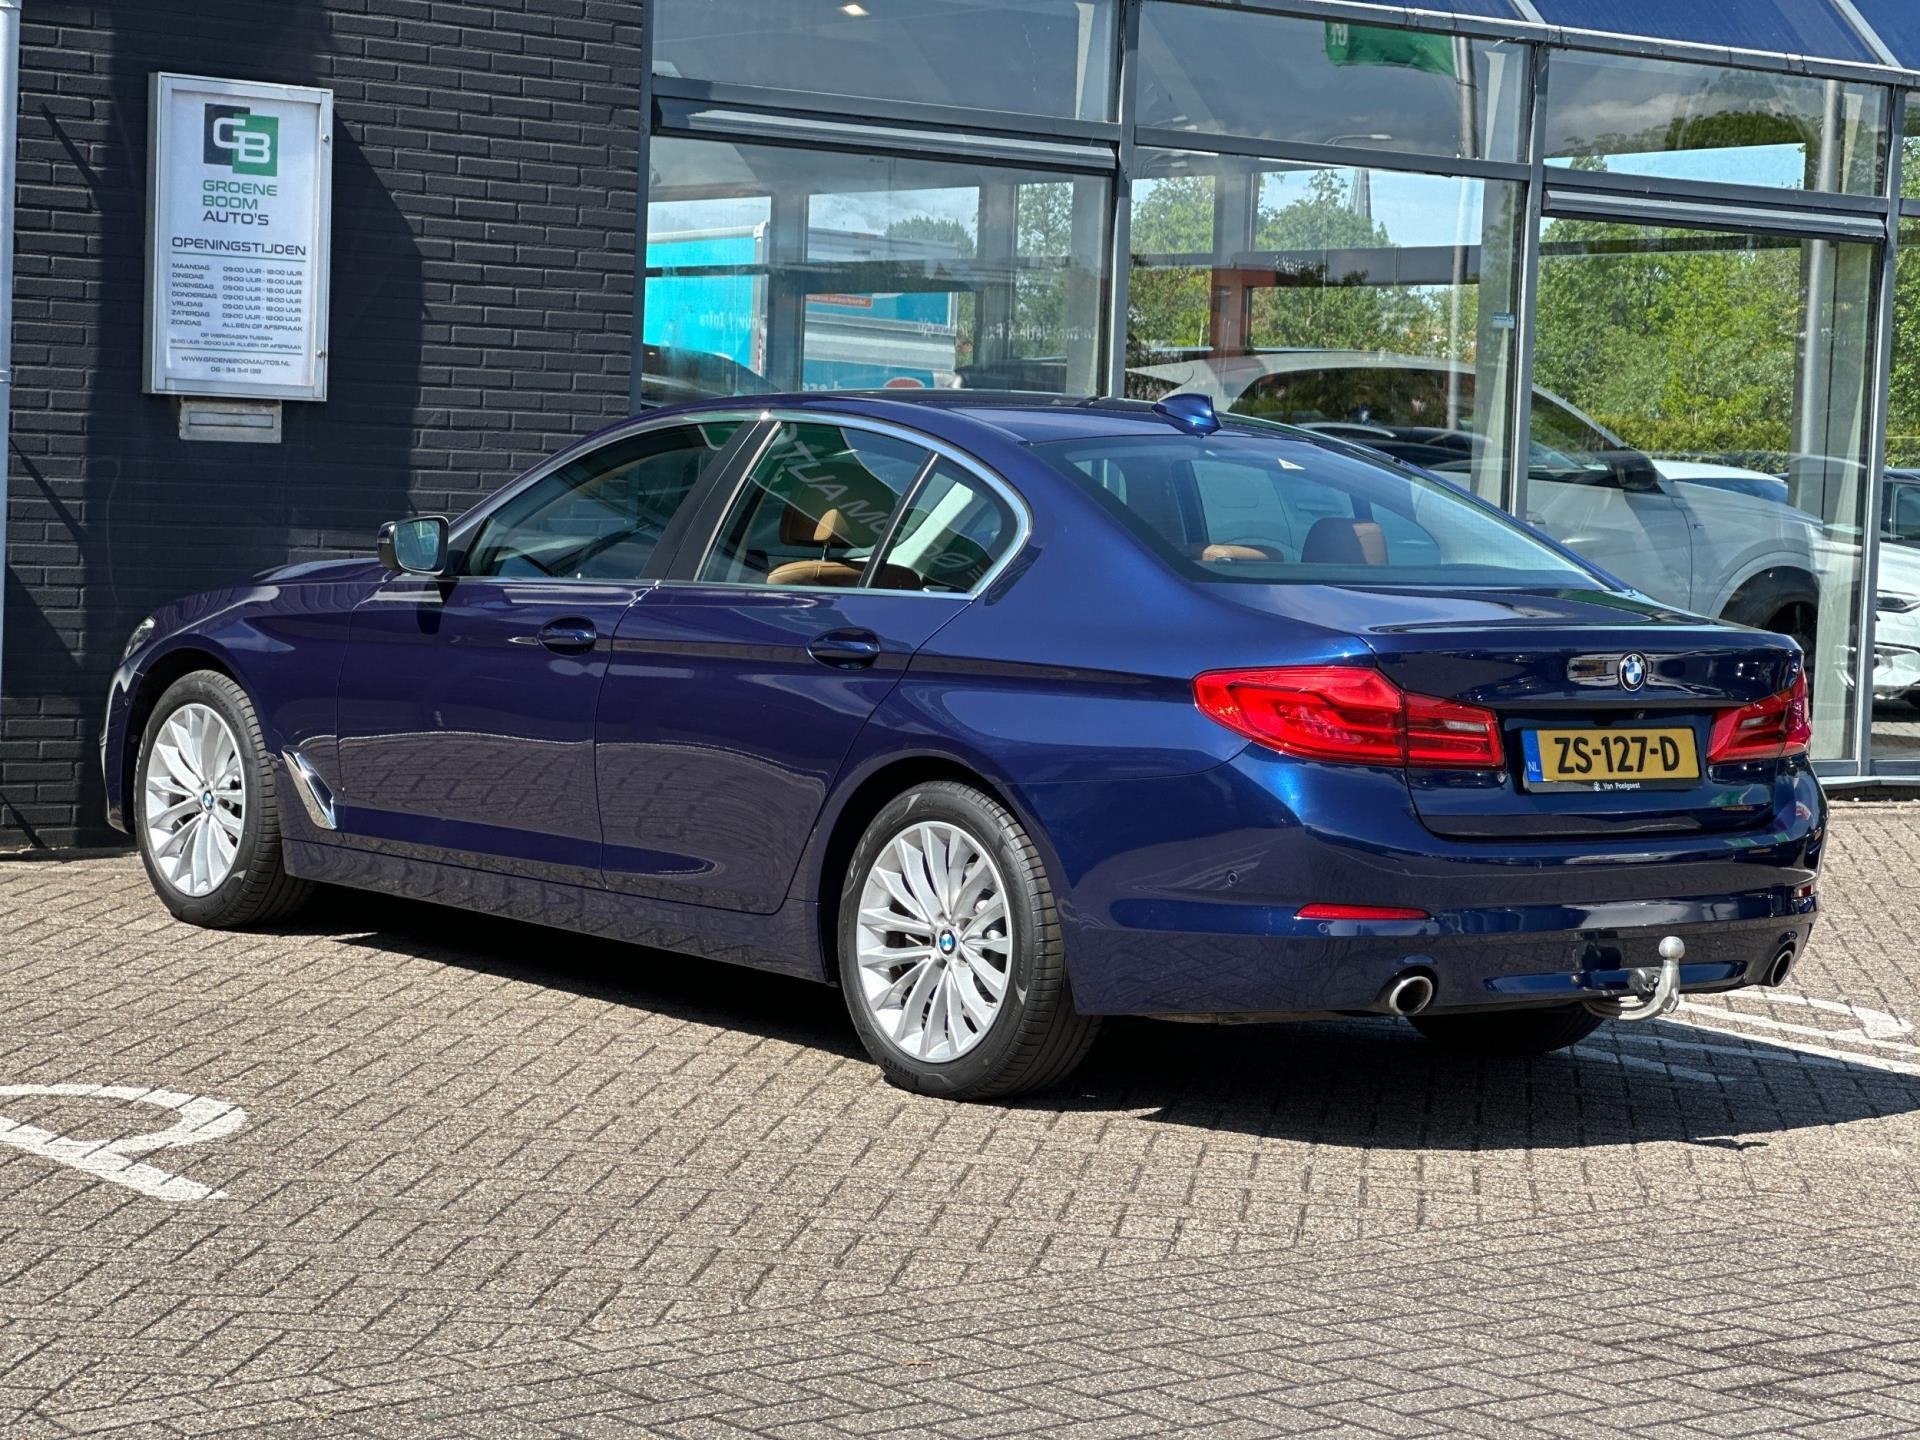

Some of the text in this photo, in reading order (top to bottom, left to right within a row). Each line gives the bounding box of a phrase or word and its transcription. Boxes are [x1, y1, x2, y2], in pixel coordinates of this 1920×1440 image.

[203, 180, 277, 196] GROENE
[203, 195, 258, 210] BOOM
[203, 210, 269, 226] AUTO'S
[172, 237, 306, 256] OPENINGSTIJDEN
[172, 281, 214, 289] WOENSDAG
[172, 291, 217, 299] DONDERDAG
[171, 300, 203, 308] VRIJDAG
[171, 309, 210, 317] ZATERDAG
[264, 324, 303, 332] AFSPRAAK
[1554, 735, 1680, 774] ZS-127-D
[1527, 761, 1541, 773] NL
